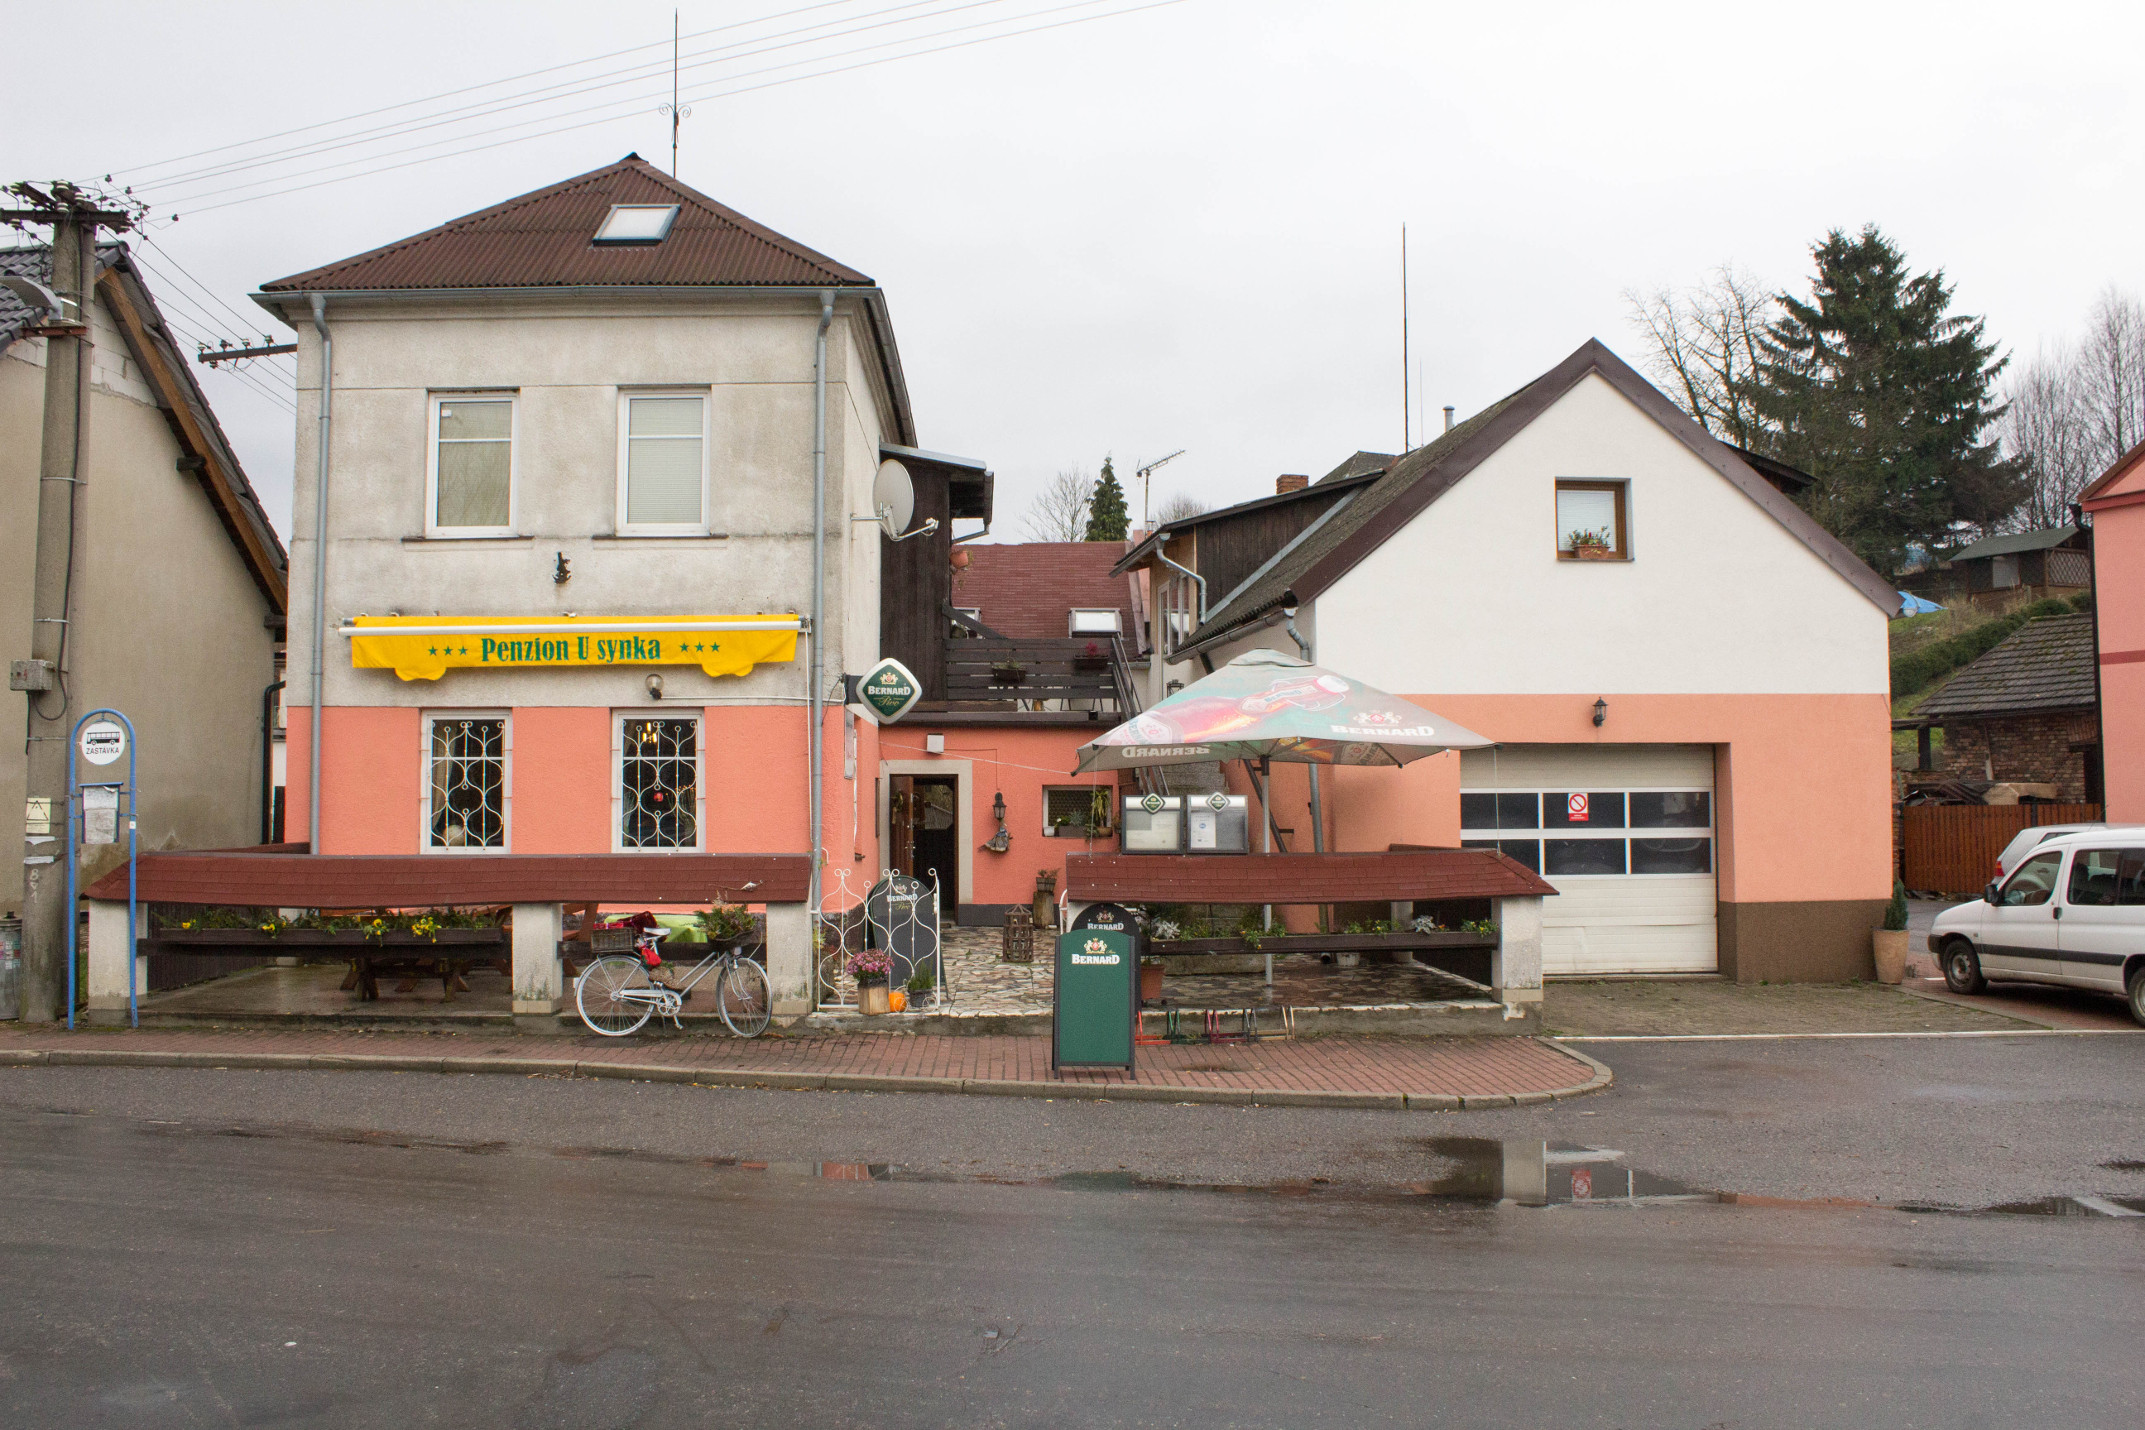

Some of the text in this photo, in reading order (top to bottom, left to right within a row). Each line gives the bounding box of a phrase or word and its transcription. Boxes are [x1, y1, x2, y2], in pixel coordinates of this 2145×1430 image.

[481, 636, 662, 664] Penzion U synka
[867, 685, 911, 696] BERNARD
[1330, 724, 1435, 737] BERNARD
[1071, 953, 1121, 965] BERNARD
